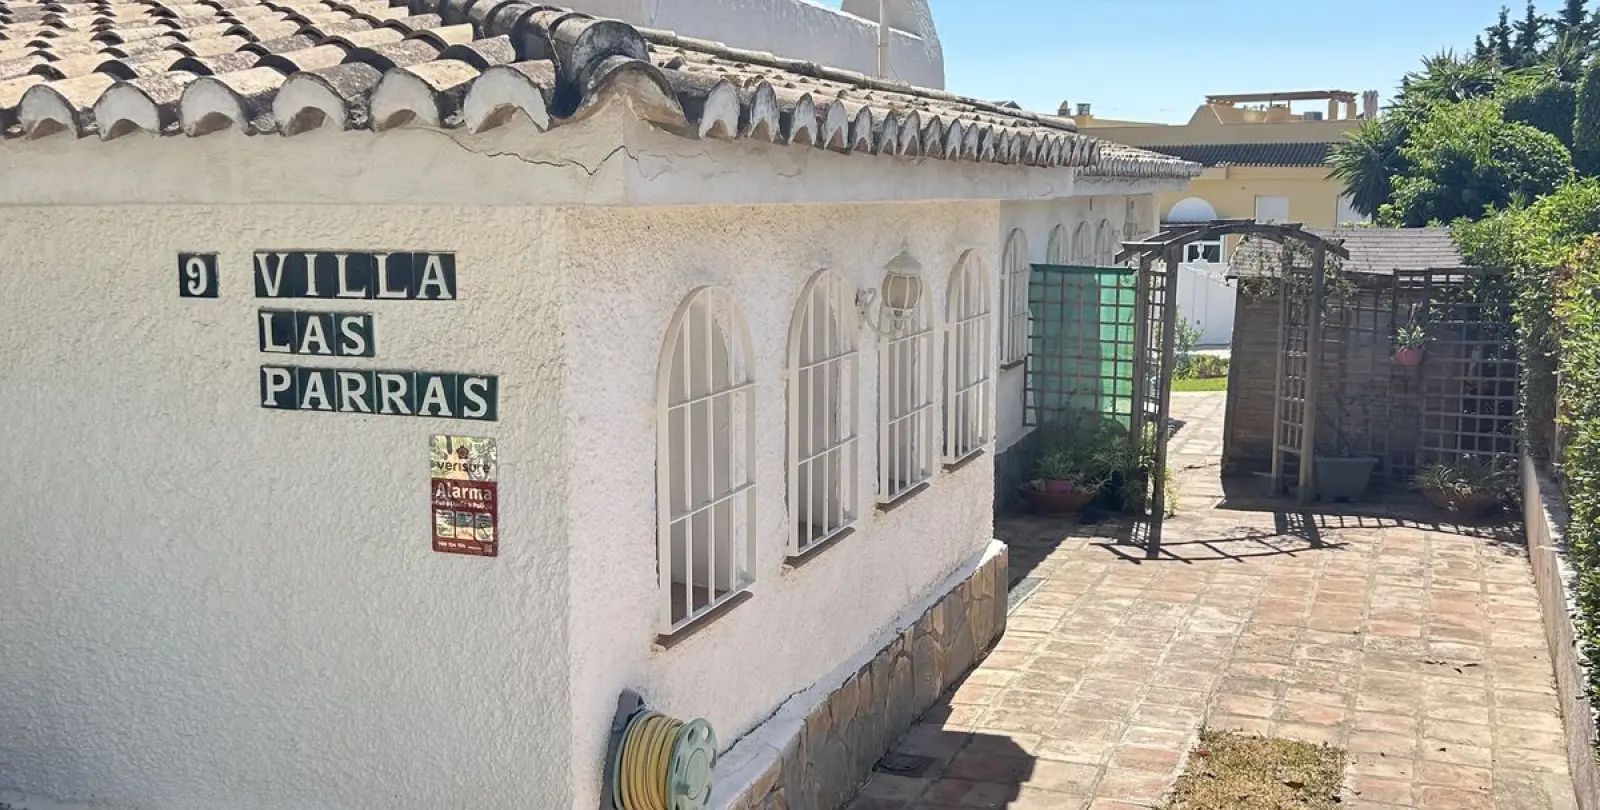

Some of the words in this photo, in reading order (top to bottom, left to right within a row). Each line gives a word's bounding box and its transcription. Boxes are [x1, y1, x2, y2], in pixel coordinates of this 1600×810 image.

[186, 257, 208, 296] 9
[255, 253, 453, 300] VILLA
[260, 313, 367, 356] LAS
[262, 367, 489, 418] PARRAS
[435, 482, 492, 501] Alarma
